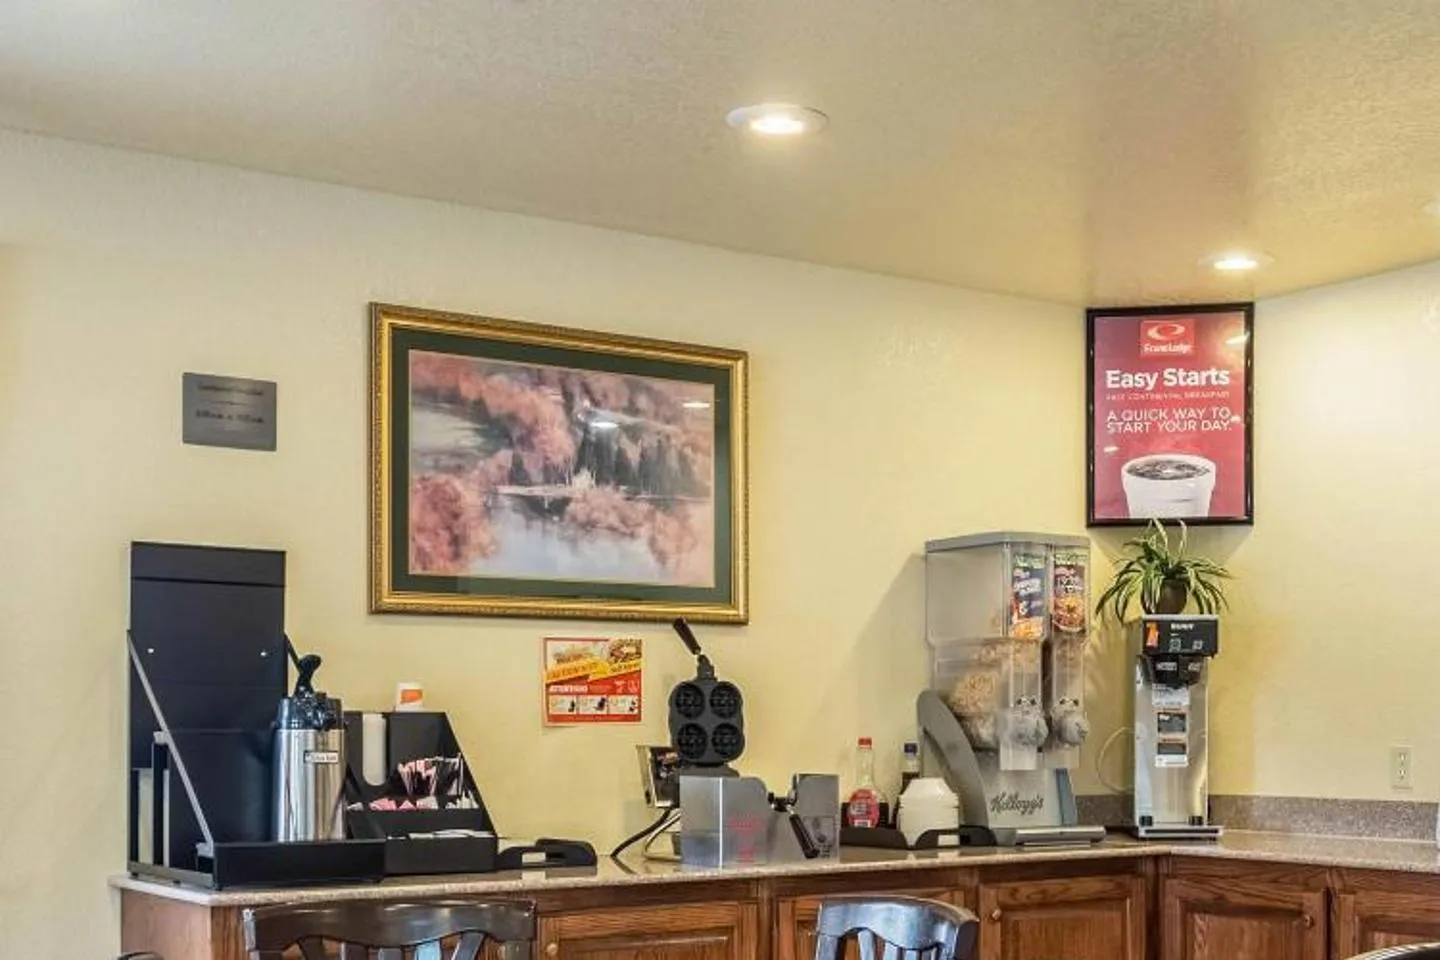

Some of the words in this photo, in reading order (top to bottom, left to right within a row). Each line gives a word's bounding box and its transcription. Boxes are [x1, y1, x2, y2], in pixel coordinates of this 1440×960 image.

[1105, 369, 1158, 390] Easy
[1163, 367, 1230, 386] Starts
[1106, 409, 1118, 421] A
[1121, 408, 1168, 421] QUICK
[1172, 407, 1206, 419] WAY
[1211, 406, 1231, 419] TO
[1106, 422, 1153, 434] START
[1157, 420, 1197, 433] YOUR
[1201, 420, 1233, 431] DAY.
[991, 791, 1044, 816] Kellogg's
